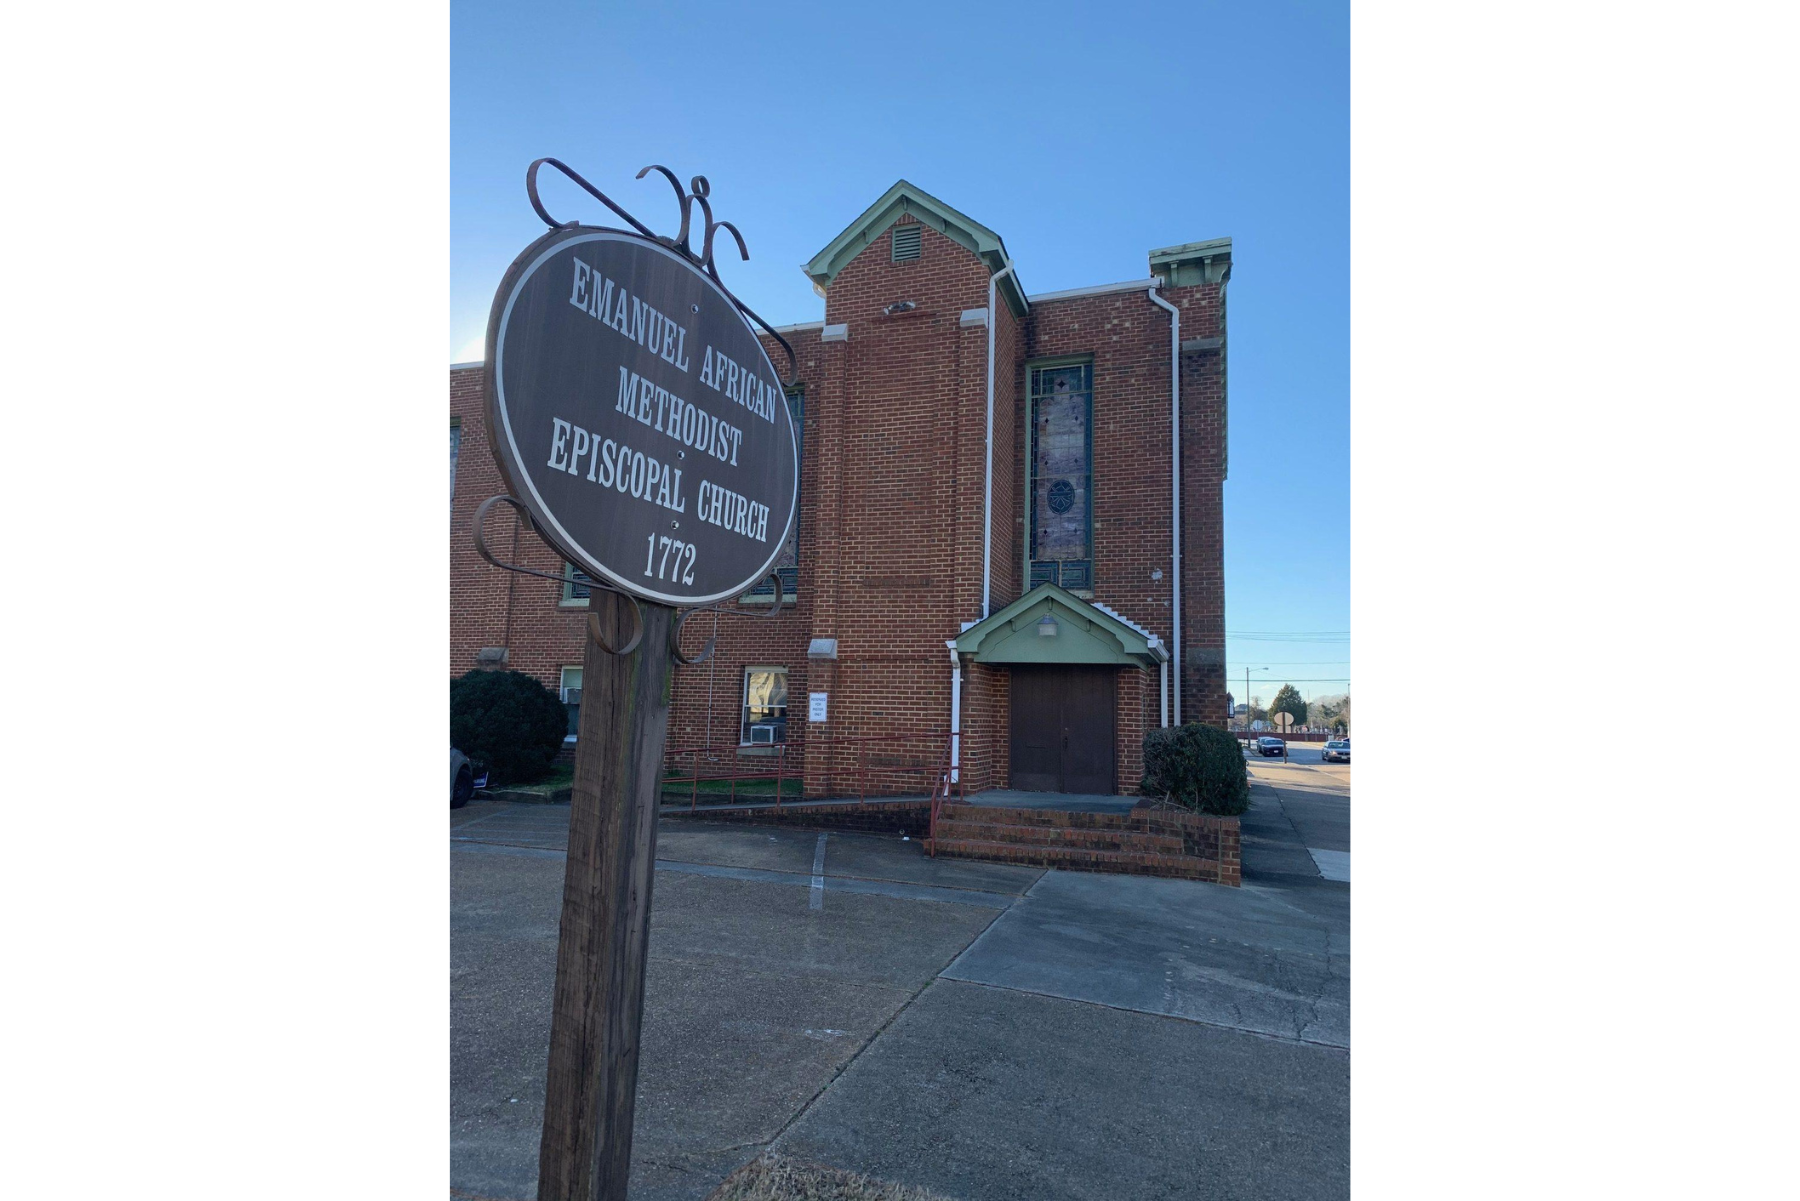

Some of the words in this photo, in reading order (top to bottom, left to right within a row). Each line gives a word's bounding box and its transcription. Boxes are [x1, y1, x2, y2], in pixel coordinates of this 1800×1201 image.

[569, 257, 689, 373] EMANUEL
[700, 345, 777, 424] AFRICAN
[615, 366, 742, 467] METHODIST
[547, 417, 685, 513] EPISCOPAL
[697, 479, 770, 543] CHURCH
[644, 532, 697, 586] 1772
